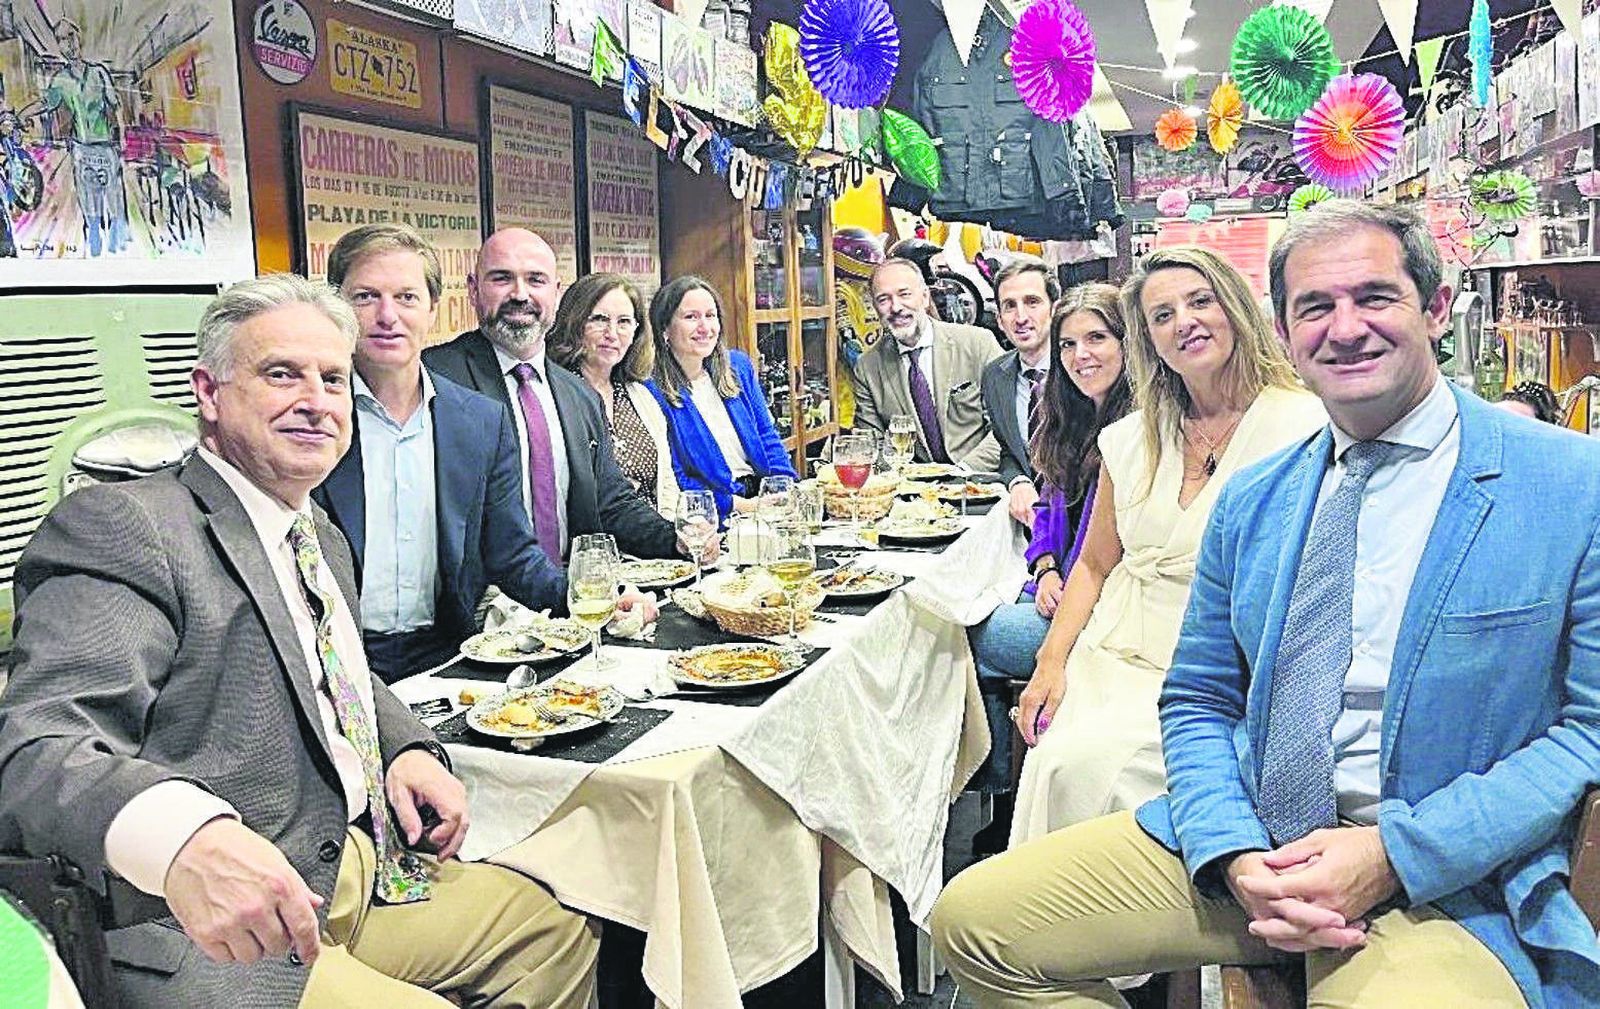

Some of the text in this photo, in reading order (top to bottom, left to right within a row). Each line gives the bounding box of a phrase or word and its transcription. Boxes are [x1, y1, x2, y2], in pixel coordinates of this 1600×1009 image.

[257, 4, 311, 54] Vespa
[352, 33, 400, 54] ALASKA
[260, 48, 309, 75] SERVIZIO
[334, 43, 370, 82] CTZ
[385, 56, 418, 93] 752
[302, 125, 477, 187] CARRERAS DE MOTOS
[307, 204, 365, 223] PLAYA
[369, 210, 389, 223] DE
[415, 213, 478, 230] VICTORIA
